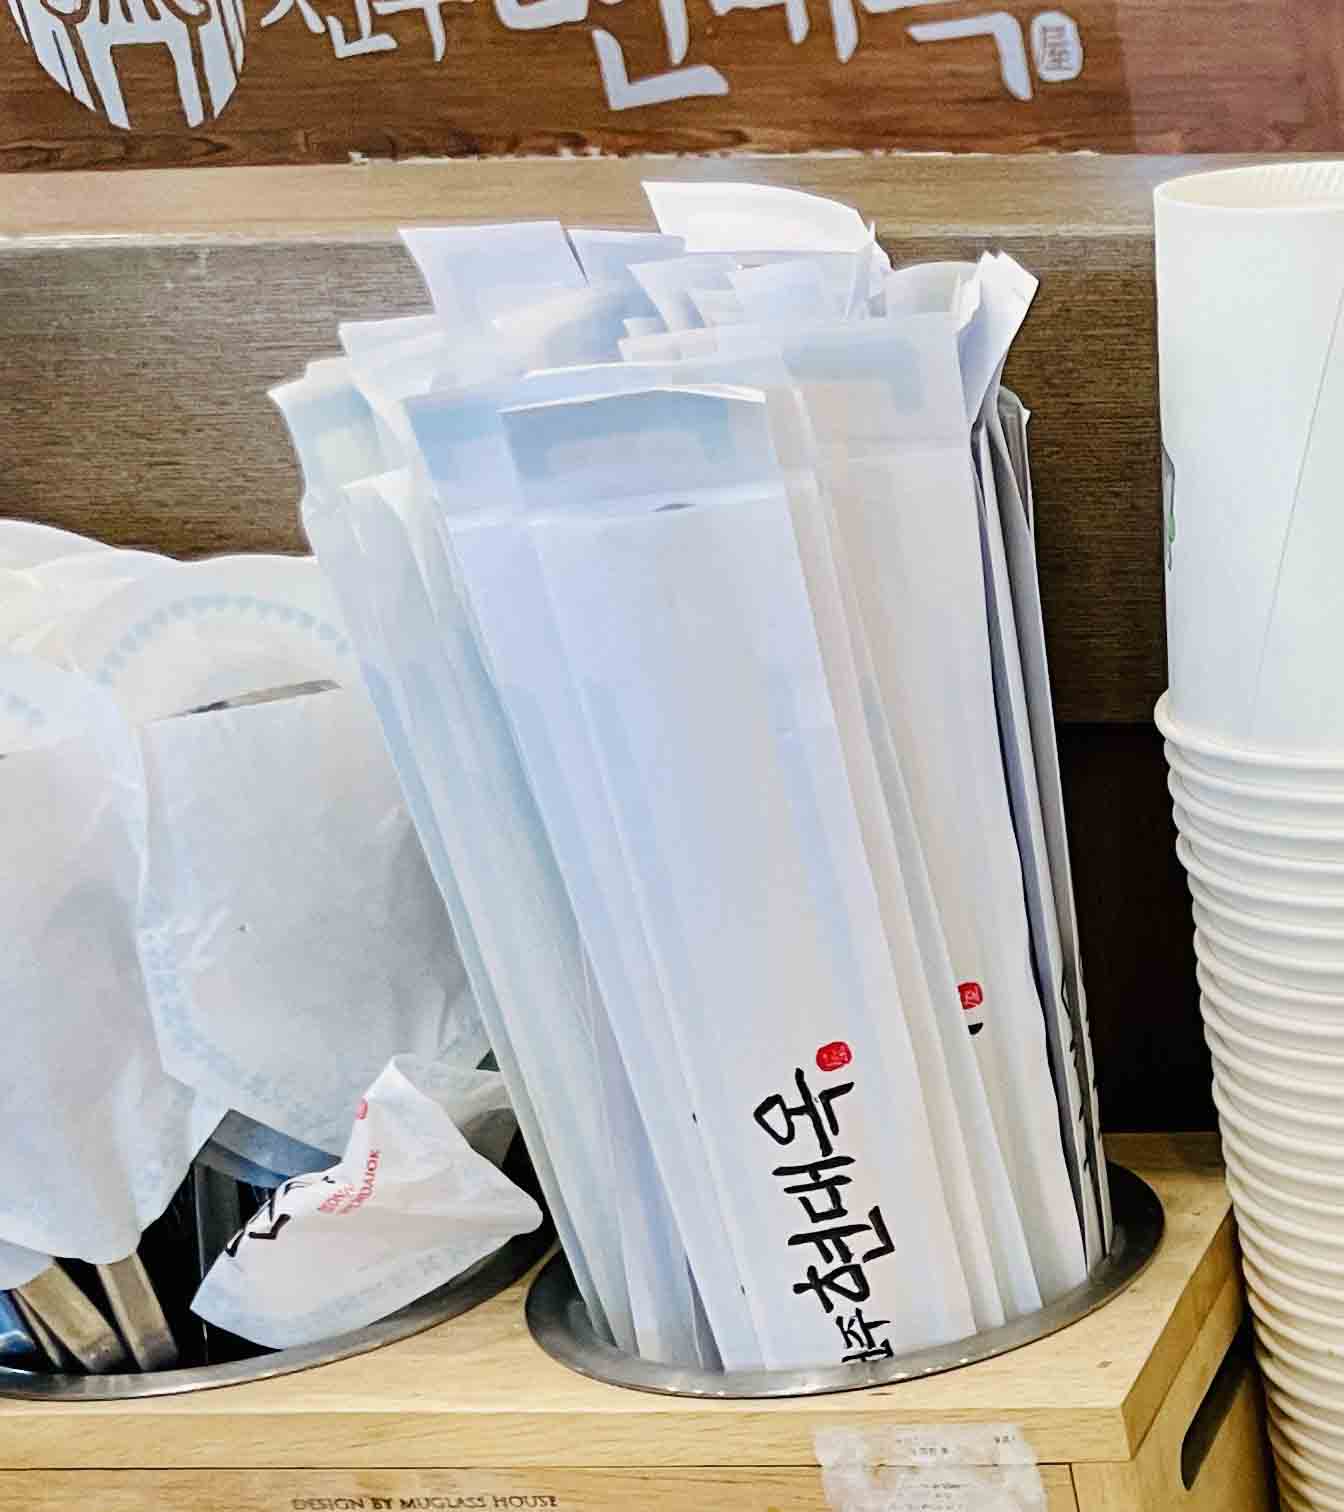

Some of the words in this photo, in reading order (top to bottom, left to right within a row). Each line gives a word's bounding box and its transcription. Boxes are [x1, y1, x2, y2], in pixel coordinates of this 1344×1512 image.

[753, 1067, 896, 1313] 현대옥
[291, 1497, 366, 1511] DESIGN
[369, 1496, 394, 1511] BY
[399, 1496, 487, 1510] MUGLASS
[493, 1495, 558, 1508] HOUSE
